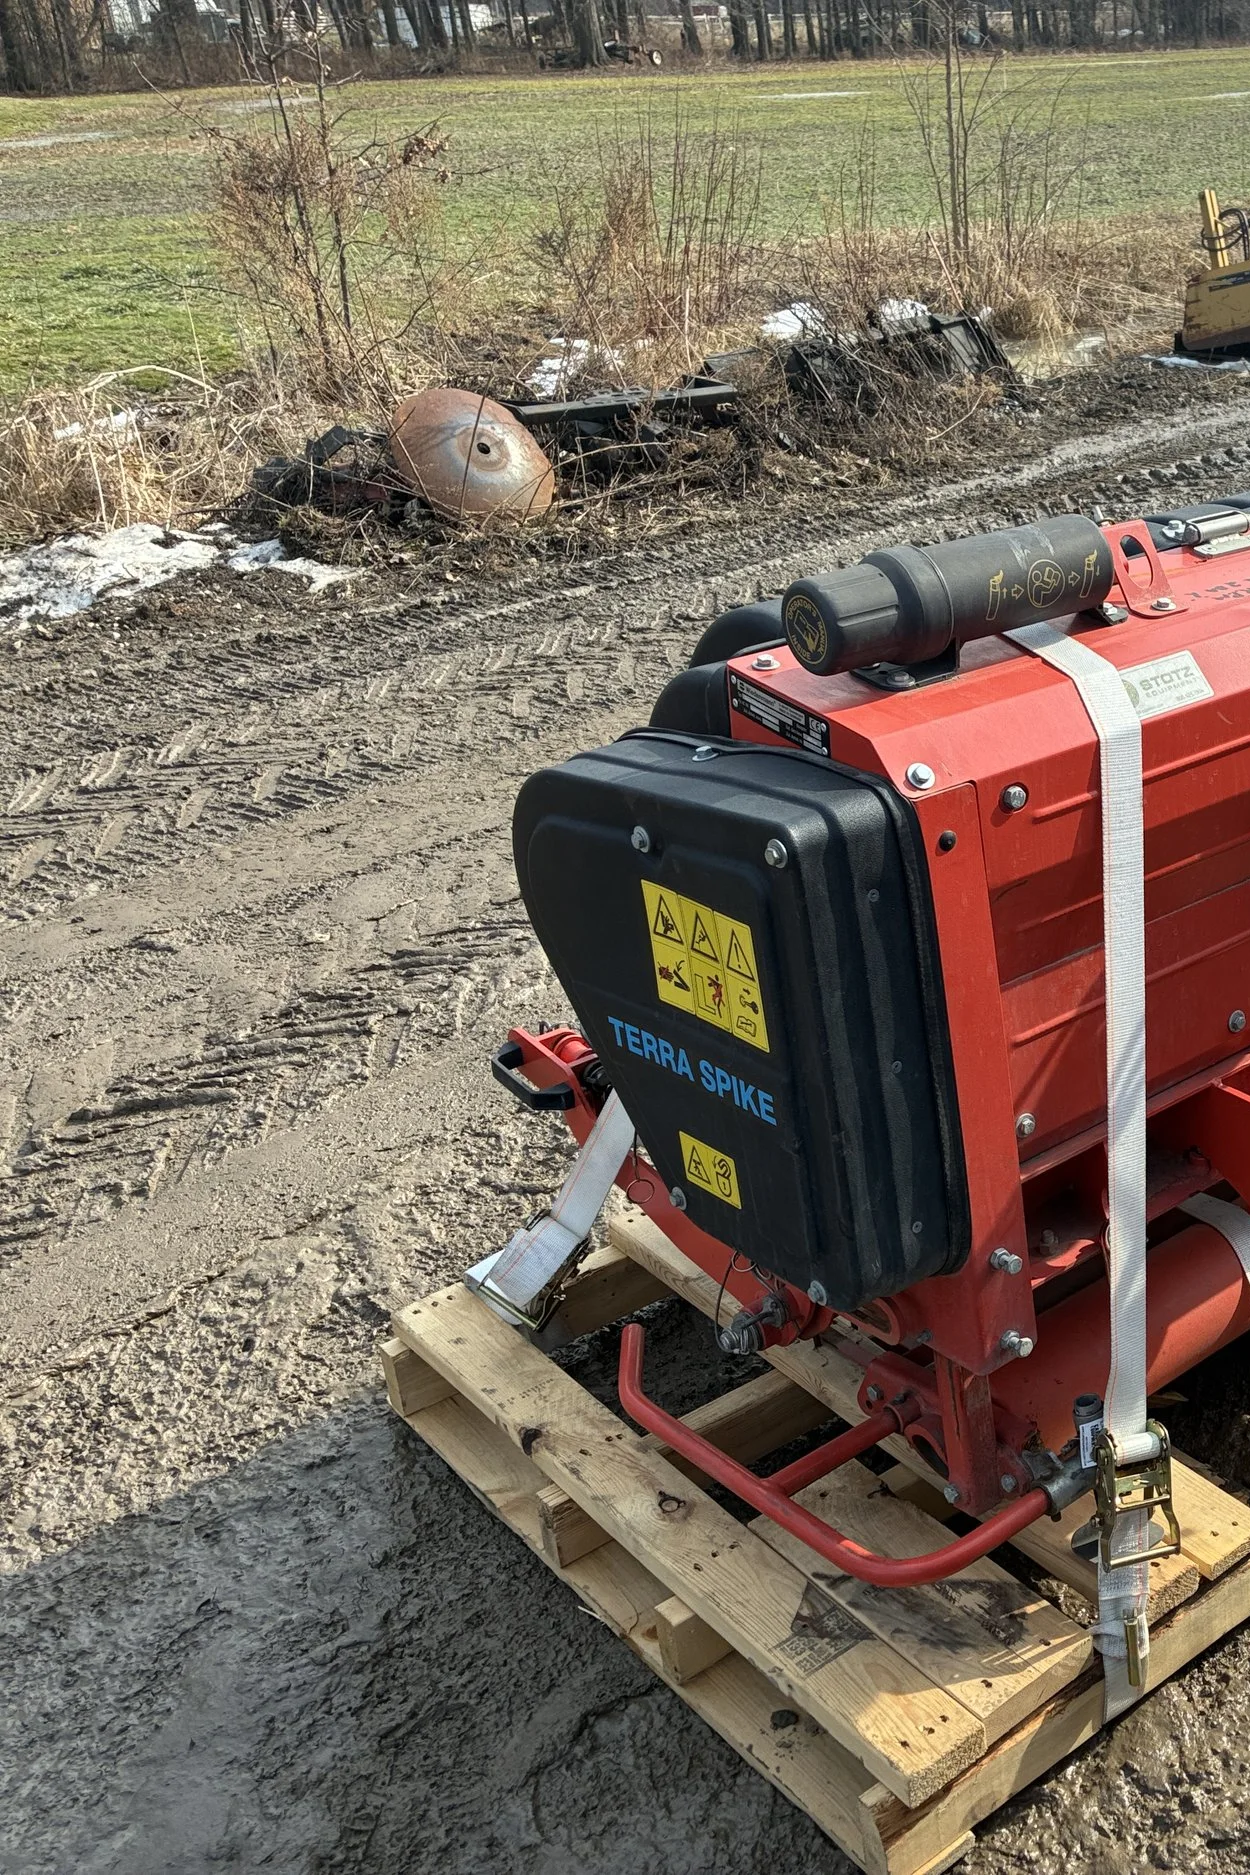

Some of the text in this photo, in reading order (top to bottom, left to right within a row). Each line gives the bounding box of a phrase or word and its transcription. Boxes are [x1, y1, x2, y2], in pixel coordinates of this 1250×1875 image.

[787, 599, 818, 620] OPERATOR'S
[791, 634, 812, 660] INSIDE
[1140, 665, 1194, 691] STOTZ
[1145, 676, 1198, 698] EQUIPMENT
[607, 1016, 778, 1126] TERRA SPIKE
